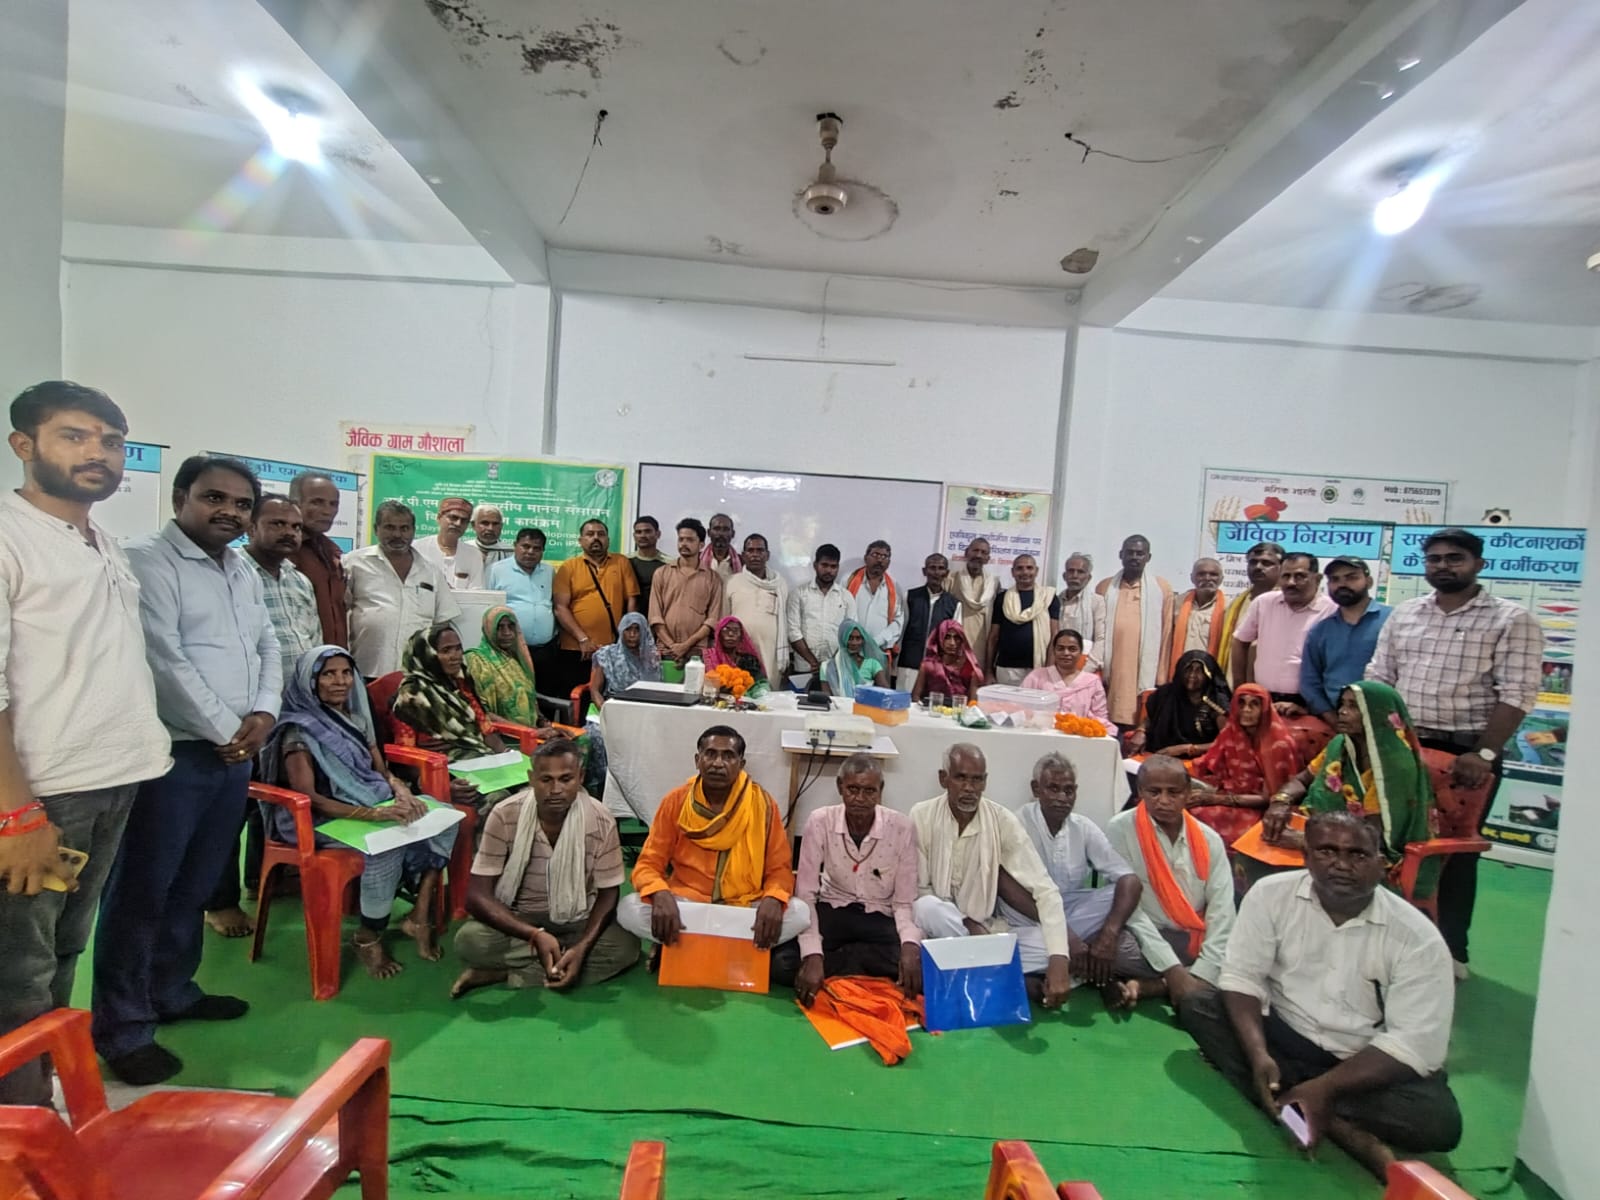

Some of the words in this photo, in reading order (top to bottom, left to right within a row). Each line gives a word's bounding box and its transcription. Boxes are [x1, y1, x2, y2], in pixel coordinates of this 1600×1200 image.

[345, 427, 383, 447] जैविक
[417, 432, 465, 452] गौशाला
[1225, 522, 1289, 542] जैविक
[1292, 523, 1375, 546] नियंत्रण
[1500, 556, 1579, 574] वर्गीकरण
